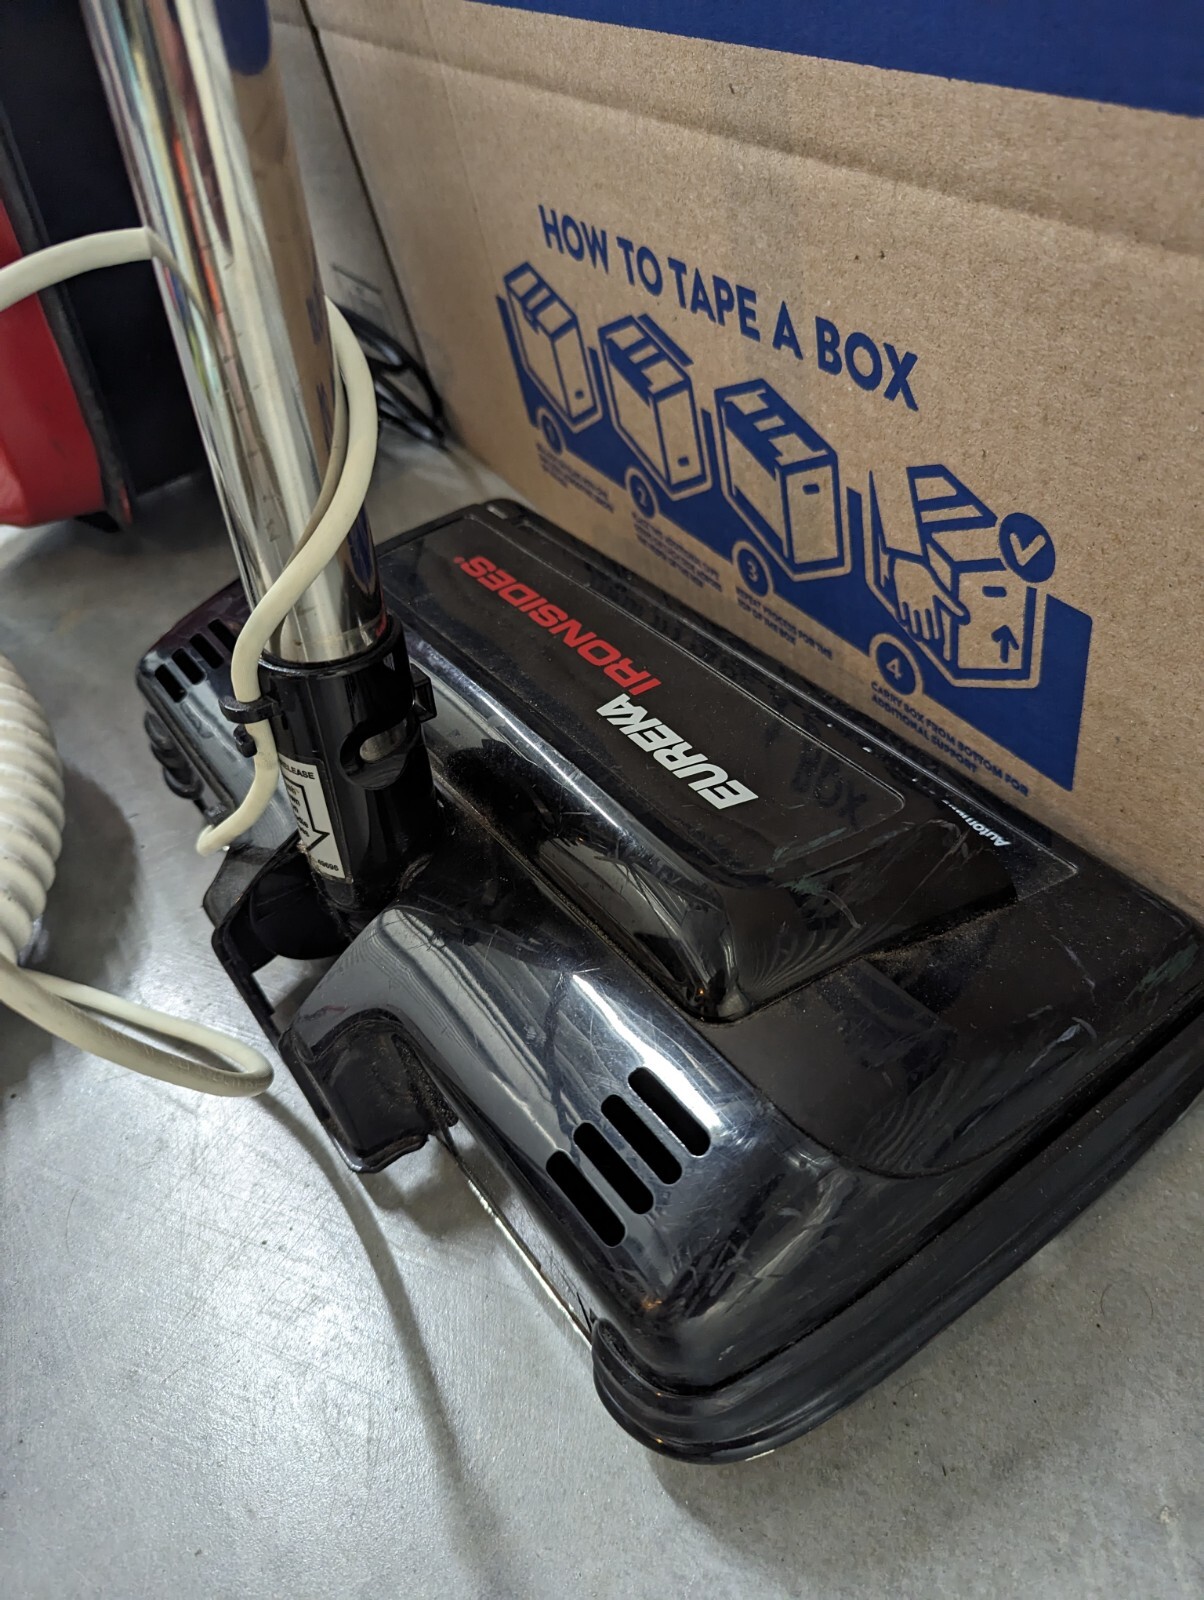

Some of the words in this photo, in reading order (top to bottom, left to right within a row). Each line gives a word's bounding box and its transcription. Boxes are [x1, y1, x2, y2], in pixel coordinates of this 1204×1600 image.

[538, 204, 609, 275] HOW
[616, 236, 663, 296] TO
[667, 257, 761, 343] TAPE
[772, 301, 803, 360] A
[815, 316, 919, 411] BOX
[637, 485, 648, 507] 2
[747, 560, 759, 582] 3
[886, 658, 903, 680] 4
[596, 693, 759, 810] EUREKA
[871, 681, 902, 707] CARRY
[904, 702, 924, 722] BOX
[926, 718, 955, 745] FROM
[957, 740, 1003, 778] BOTTOM
[1005, 772, 1029, 796] FOR
[872, 694, 929, 740] ADDITIONAL
[931, 734, 977, 773] SUPPORT
